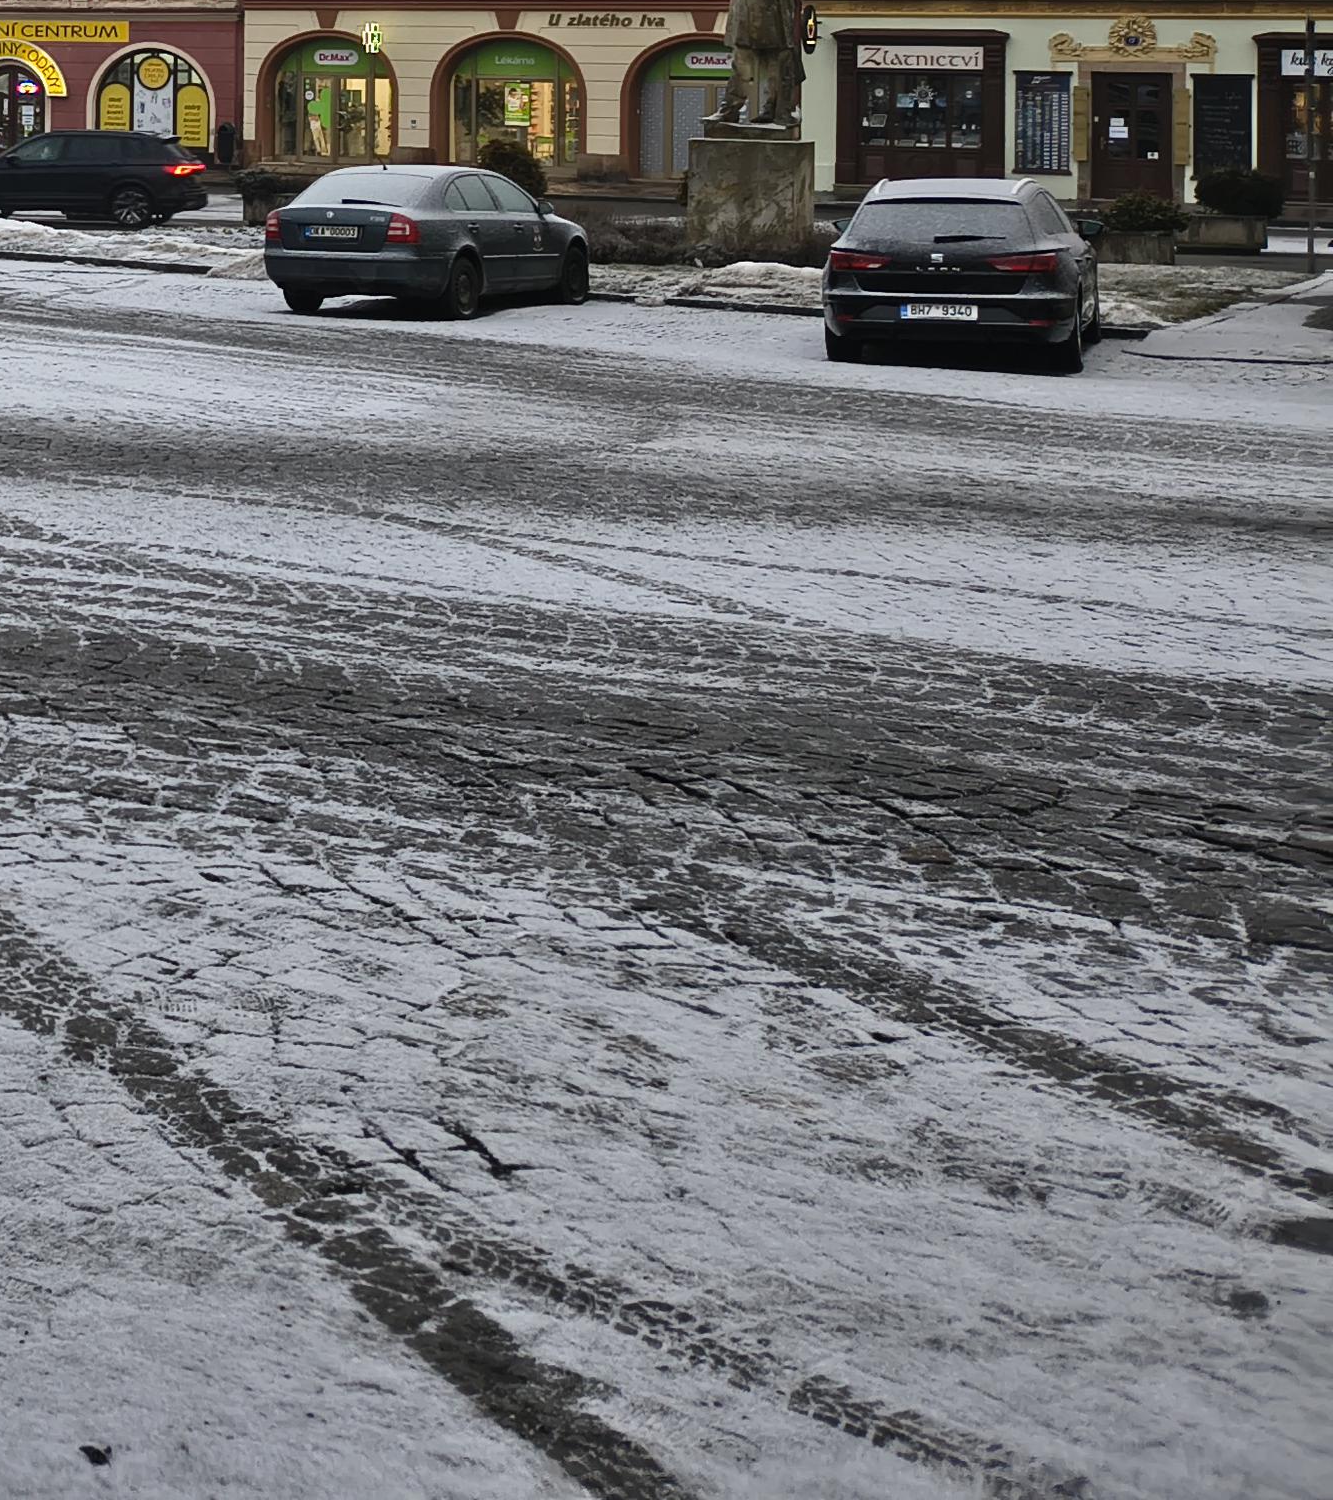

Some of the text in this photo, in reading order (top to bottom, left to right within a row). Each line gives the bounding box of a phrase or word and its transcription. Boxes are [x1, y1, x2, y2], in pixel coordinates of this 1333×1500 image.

[547, 13, 562, 28] U
[567, 13, 633, 28] zlatého
[20, 25, 119, 38] CENTRUM
